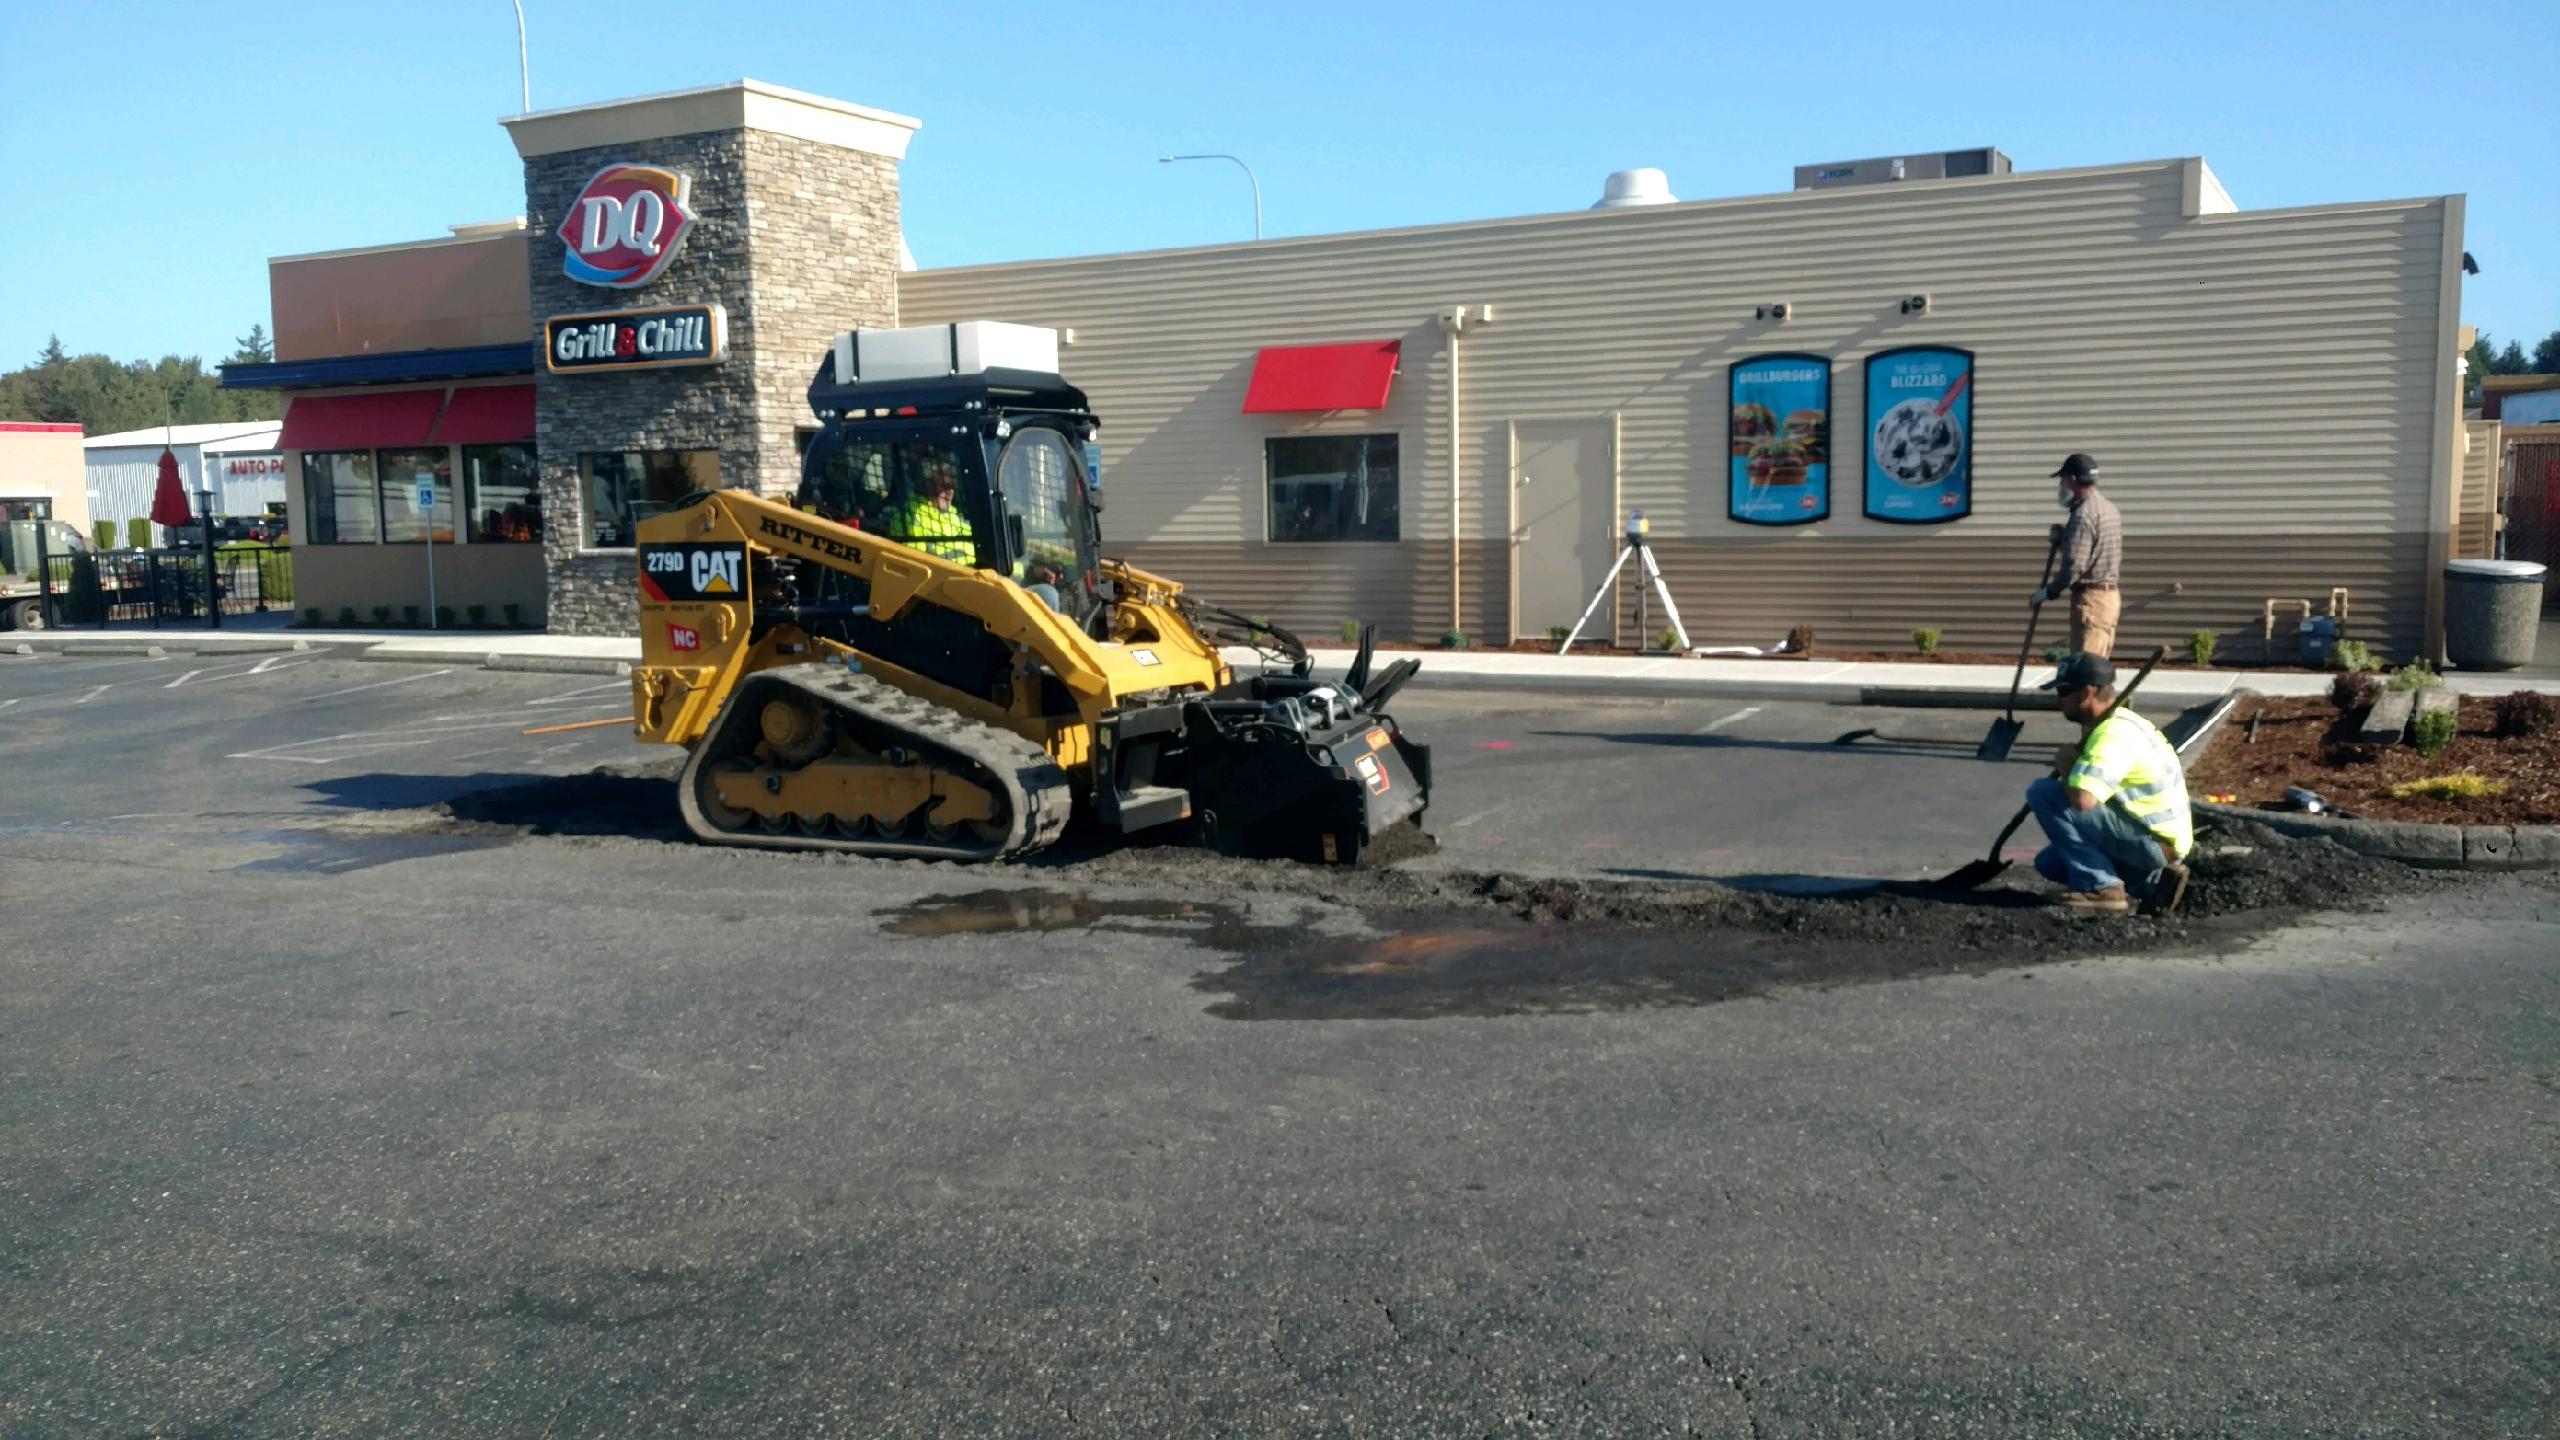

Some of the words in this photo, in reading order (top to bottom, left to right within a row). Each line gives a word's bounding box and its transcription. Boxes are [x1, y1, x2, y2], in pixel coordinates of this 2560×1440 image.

[580, 190, 663, 256] DQ
[1739, 368, 1821, 384] GRILLBURGERS
[1891, 373, 1947, 388] BLIZZARD
[230, 460, 266, 475] AUTO
[759, 515, 864, 565] RITTER
[647, 552, 684, 572] 279D
[691, 550, 742, 593] CAT
[673, 629, 697, 648] NC
